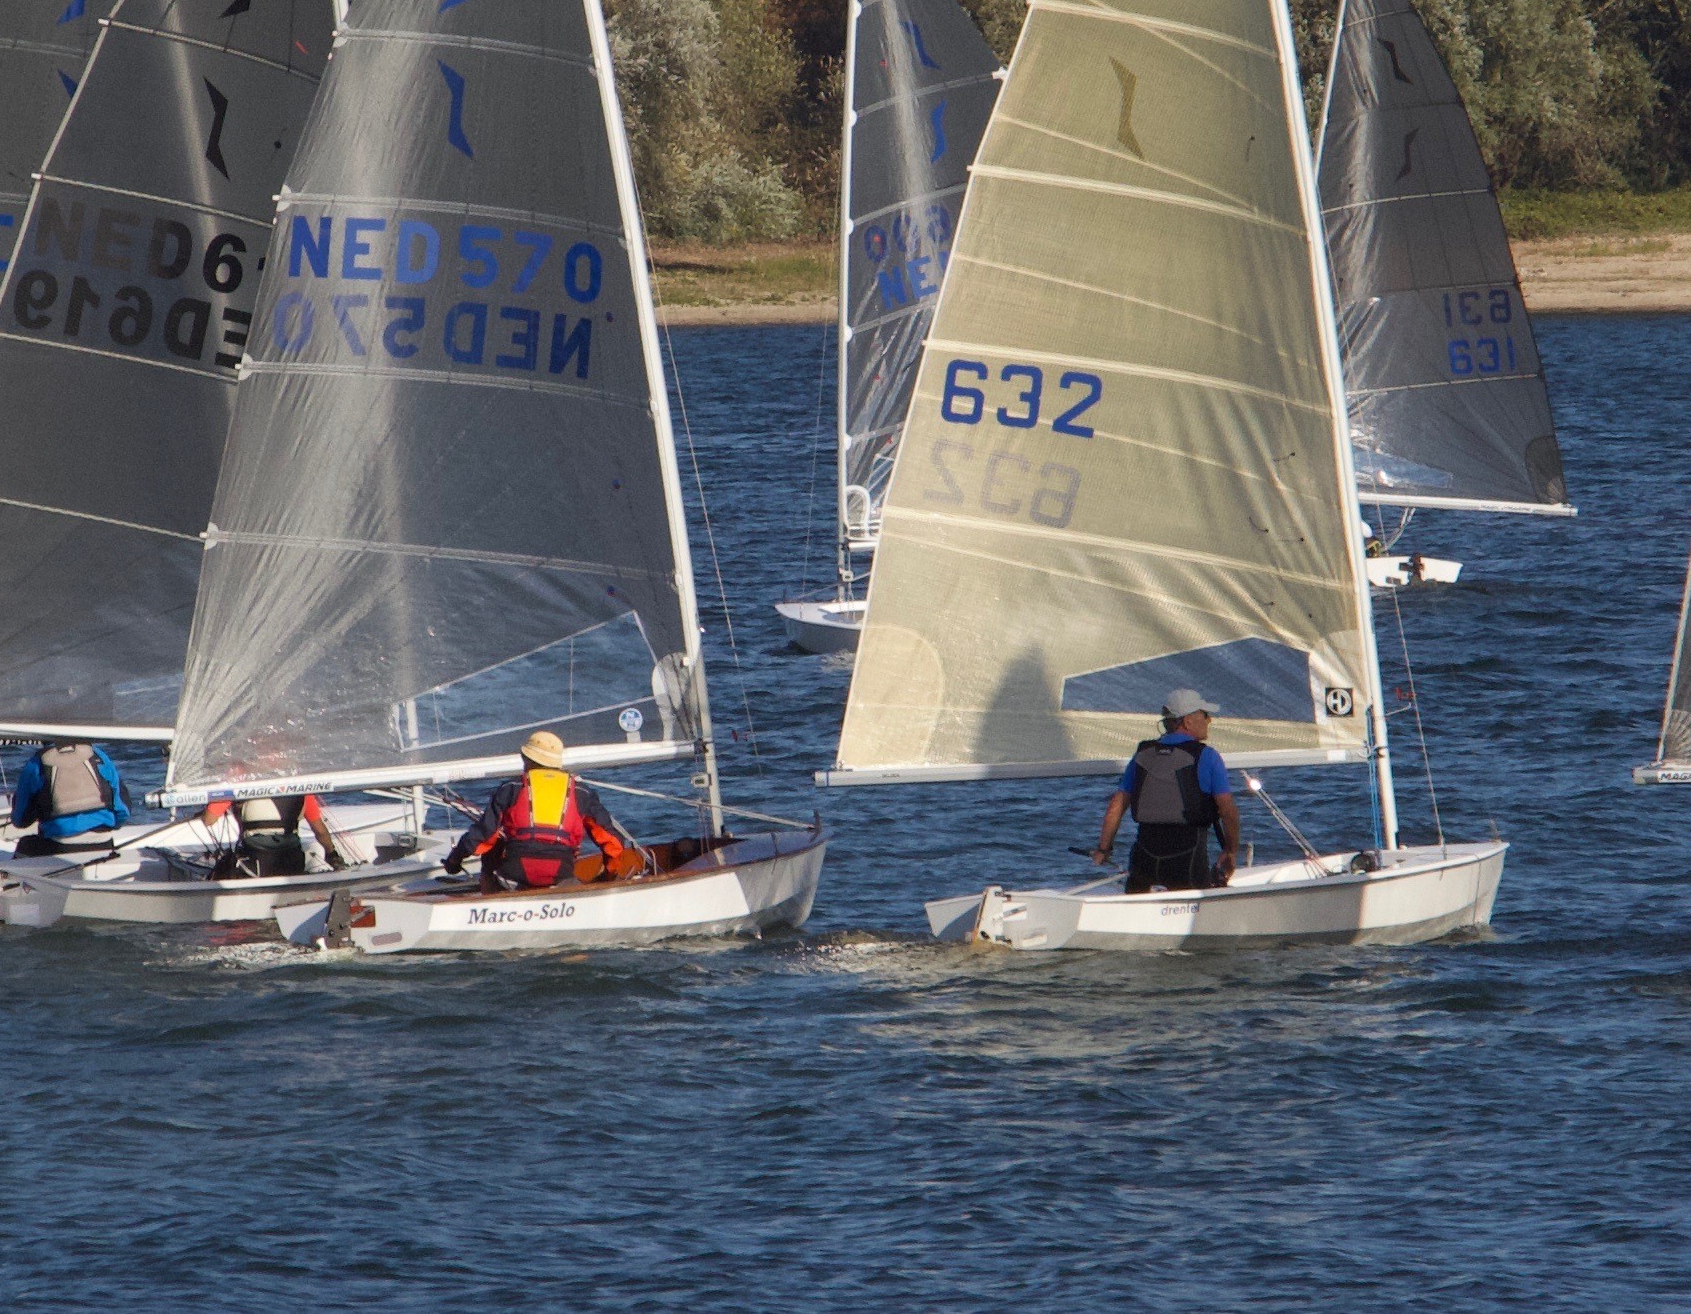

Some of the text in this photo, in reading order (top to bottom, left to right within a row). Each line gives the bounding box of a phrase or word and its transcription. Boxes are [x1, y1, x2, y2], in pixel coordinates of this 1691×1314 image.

[33, 196, 266, 294] NED6
[288, 215, 602, 304] NED570
[1447, 337, 1516, 376] 631
[941, 359, 1103, 439] 632
[236, 787, 275, 798] MAGIC
[285, 782, 332, 794] MARINE
[467, 902, 576, 925] Marc-o-Solo
